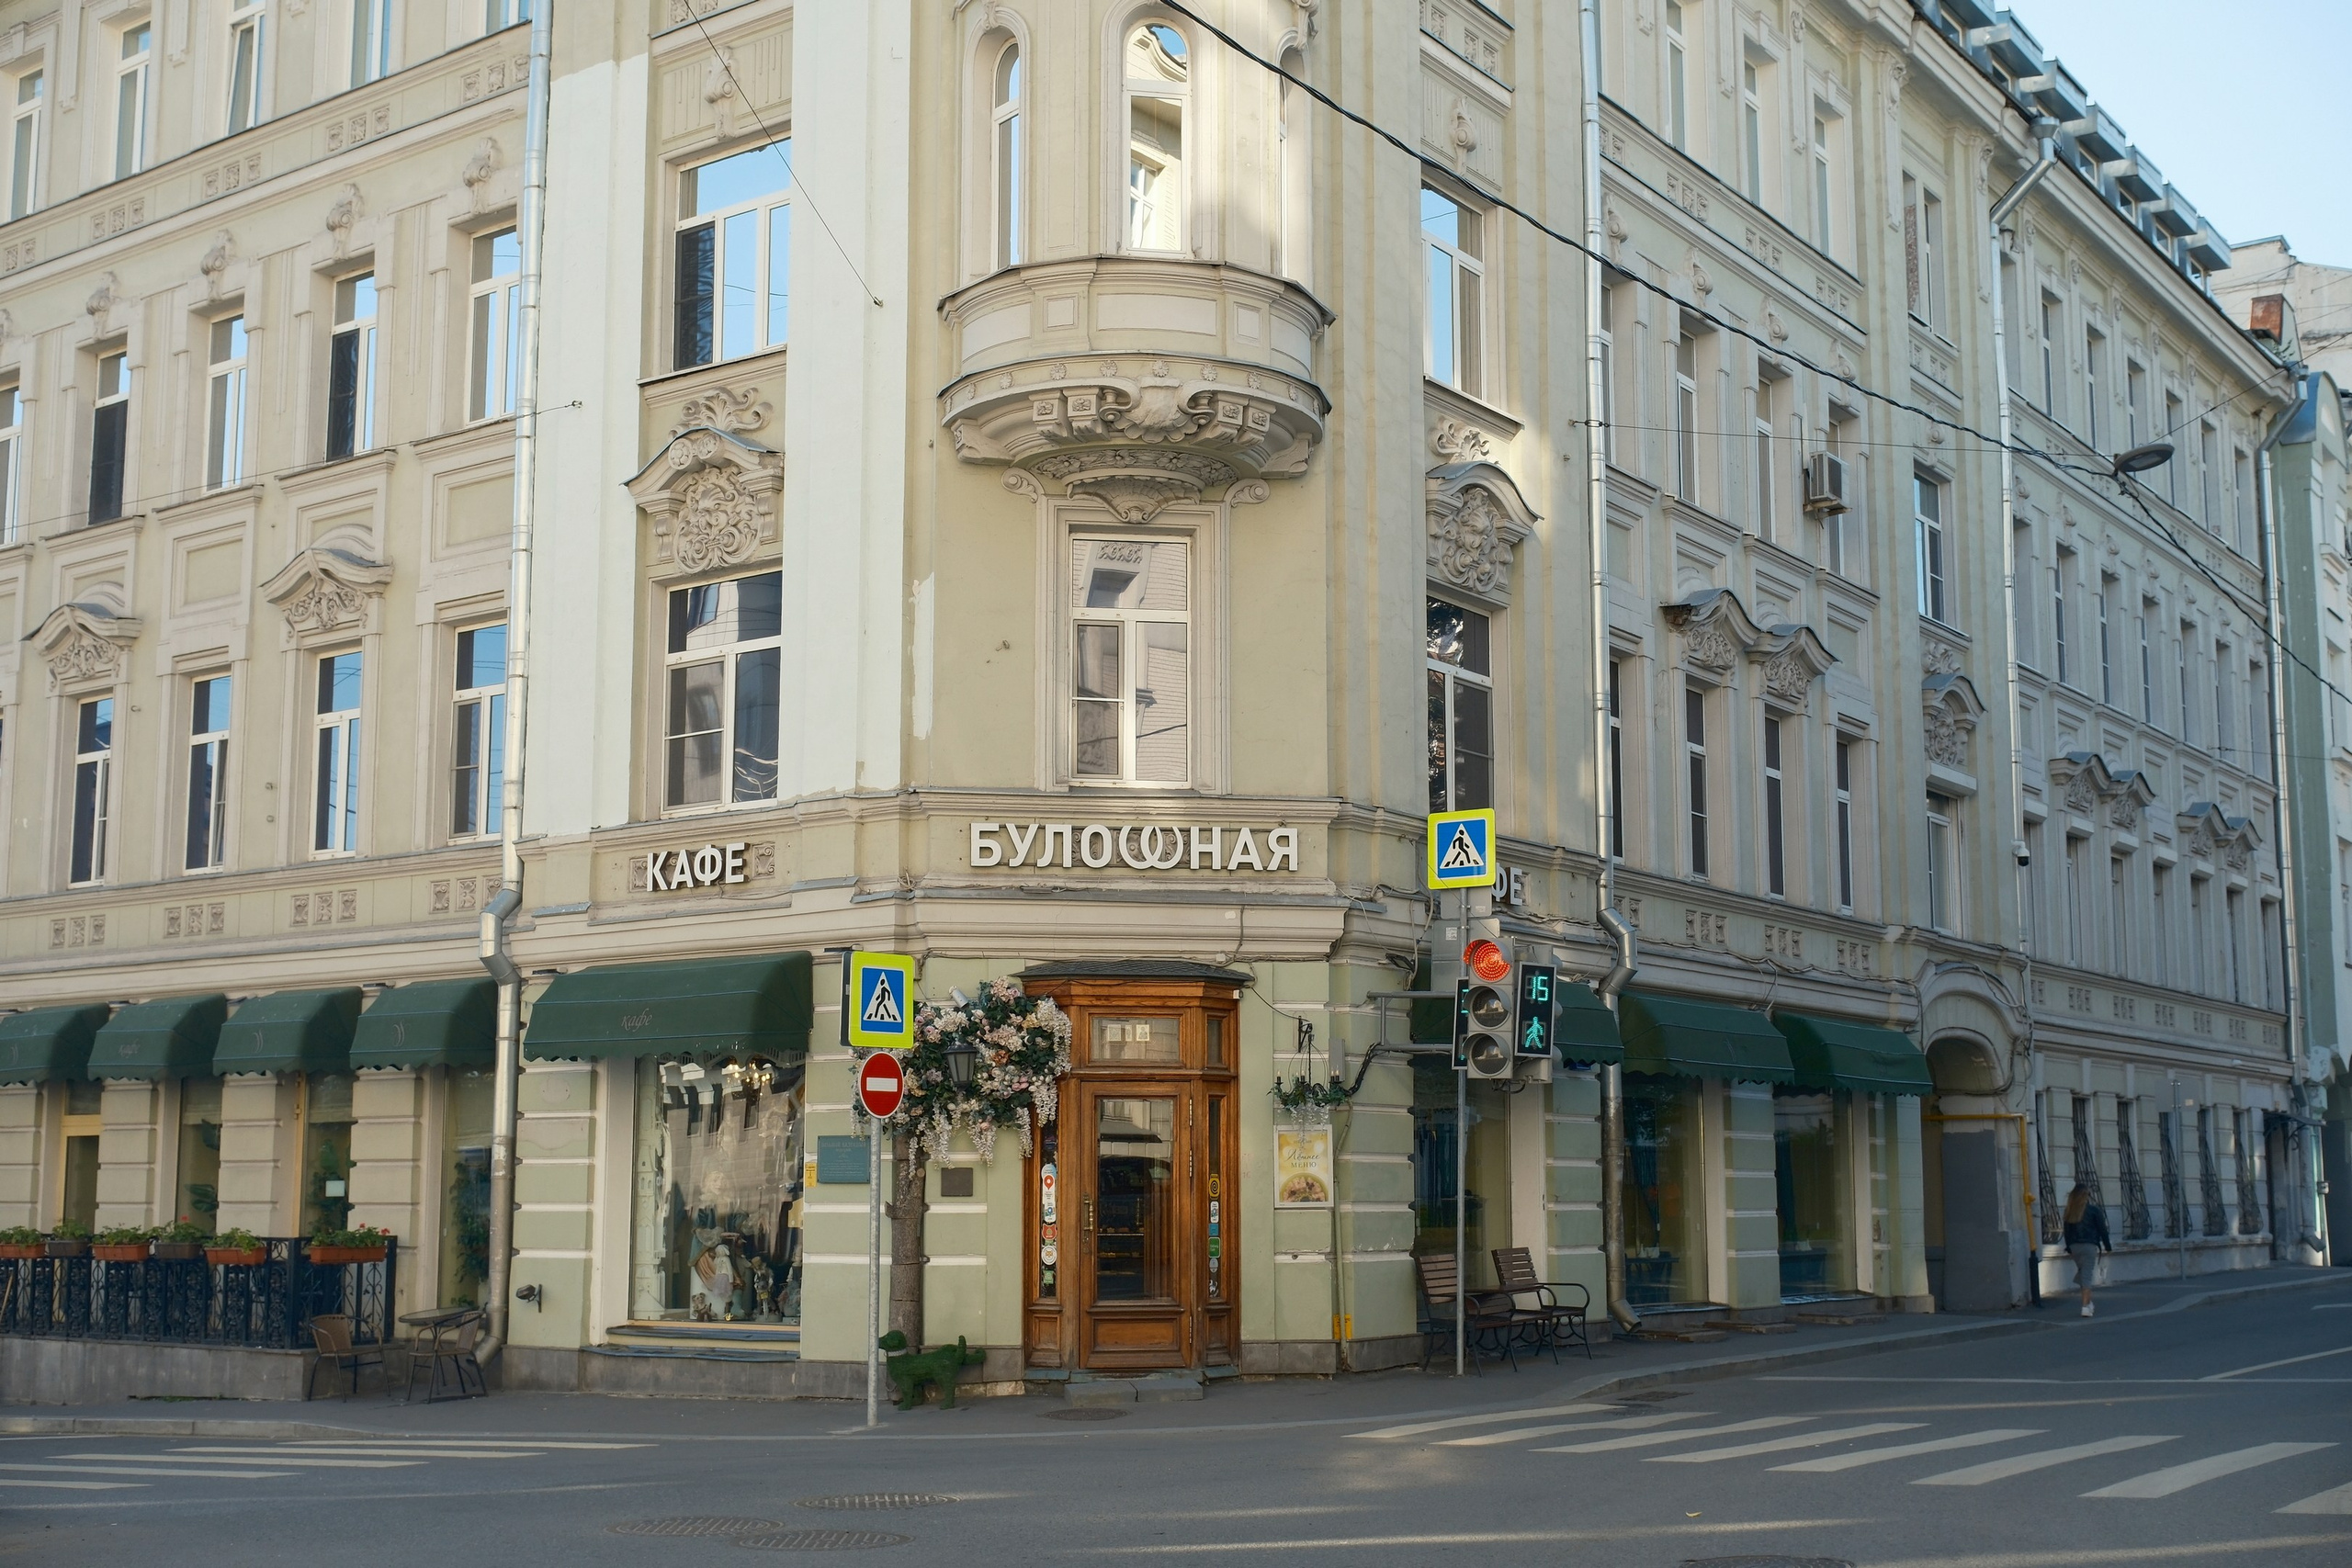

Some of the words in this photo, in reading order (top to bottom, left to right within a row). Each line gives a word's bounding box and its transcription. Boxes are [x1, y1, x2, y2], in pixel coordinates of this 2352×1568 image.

[646, 842, 746, 892] КАФЕ
[1491, 862, 1523, 906] ФЕ
[1532, 976, 1549, 1001] 15
[620, 1008, 653, 1032] кафе
